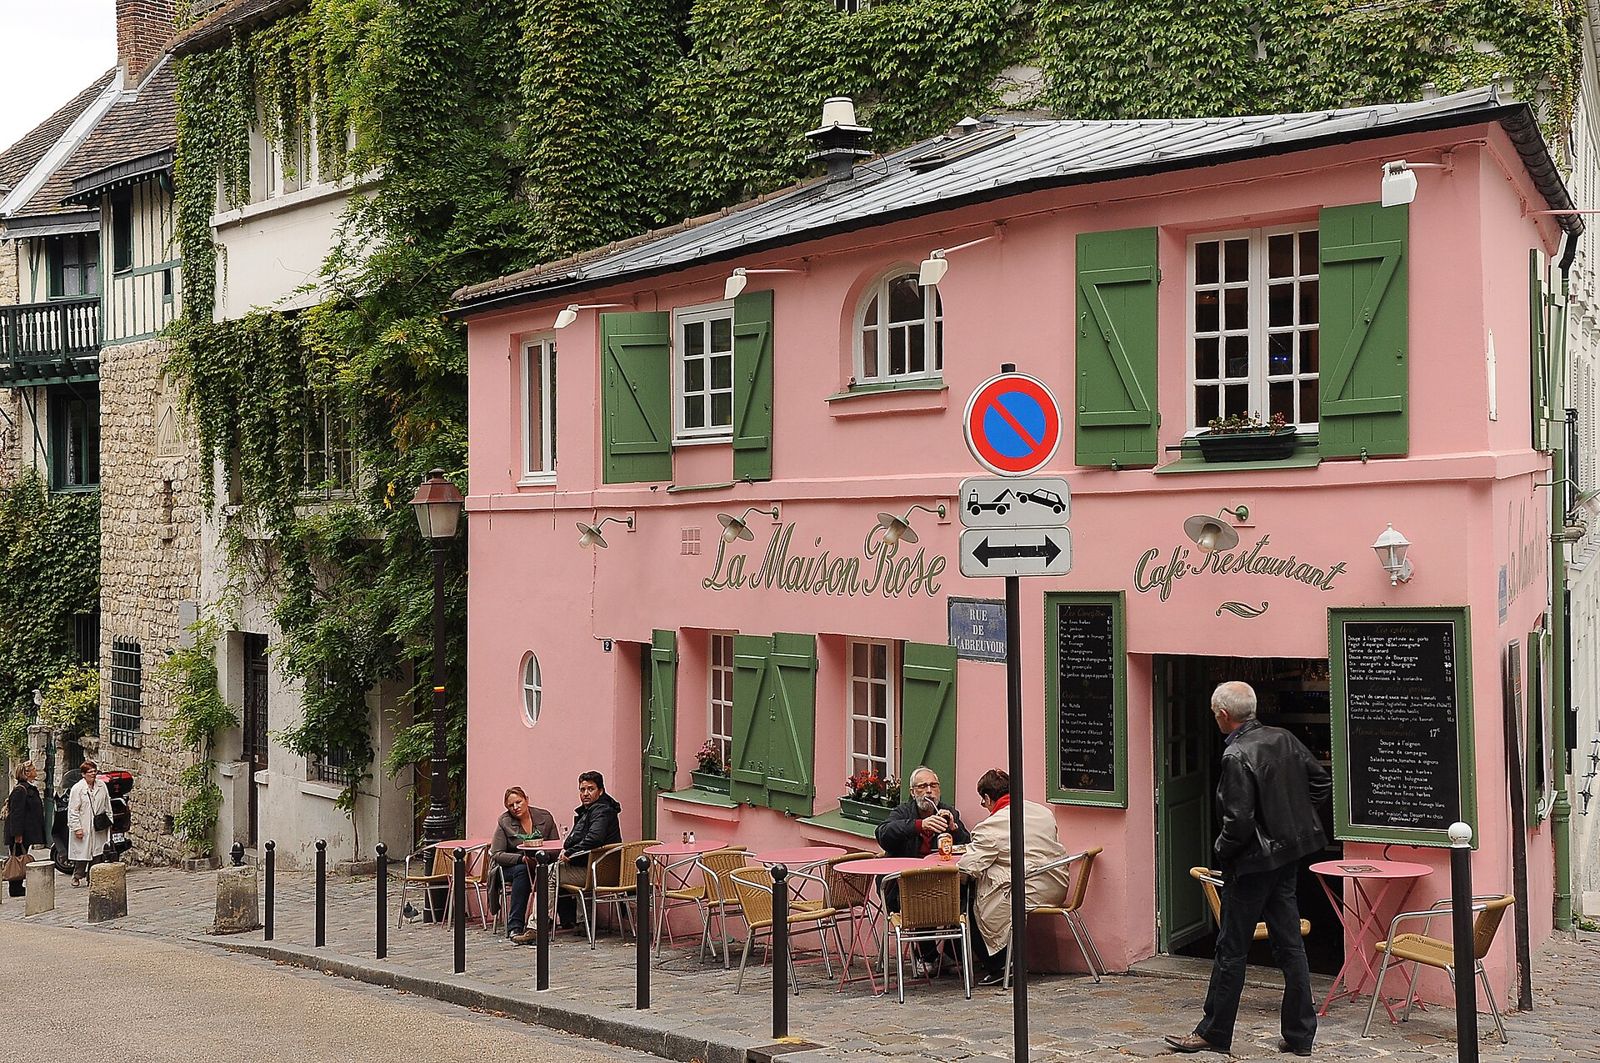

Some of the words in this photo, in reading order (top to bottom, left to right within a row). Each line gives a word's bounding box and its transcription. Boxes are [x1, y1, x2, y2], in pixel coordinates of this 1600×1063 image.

[702, 532, 747, 592] La
[749, 522, 860, 597] Maison
[861, 523, 948, 598] Rose
[970, 609, 988, 622] RUE
[973, 624, 985, 637] DE
[605, 641, 610, 651] 2
[954, 635, 1005, 654] L'ABREUVOIR
[1379, 738, 1395, 748] Soupe
